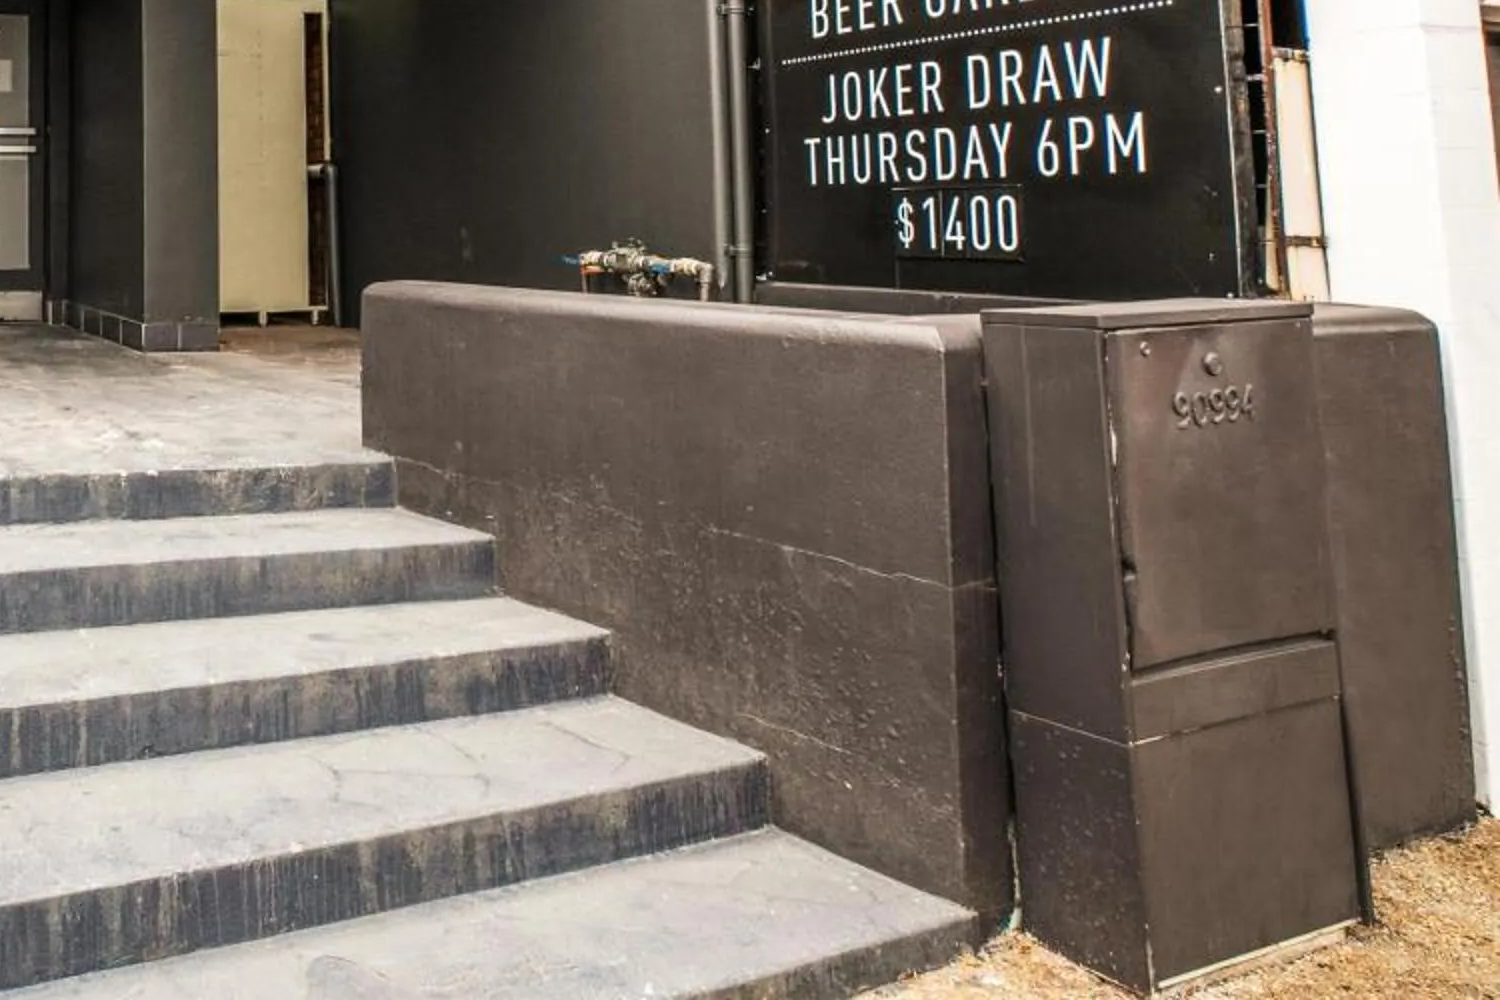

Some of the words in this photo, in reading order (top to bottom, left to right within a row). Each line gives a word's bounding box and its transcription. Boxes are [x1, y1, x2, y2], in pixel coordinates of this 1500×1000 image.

[821, 60, 944, 123] JOKER
[967, 36, 1111, 109] DRAW
[804, 122, 1012, 186] THURSDAY
[1037, 111, 1147, 177] 6PM
[896, 194, 1020, 251] $1400
